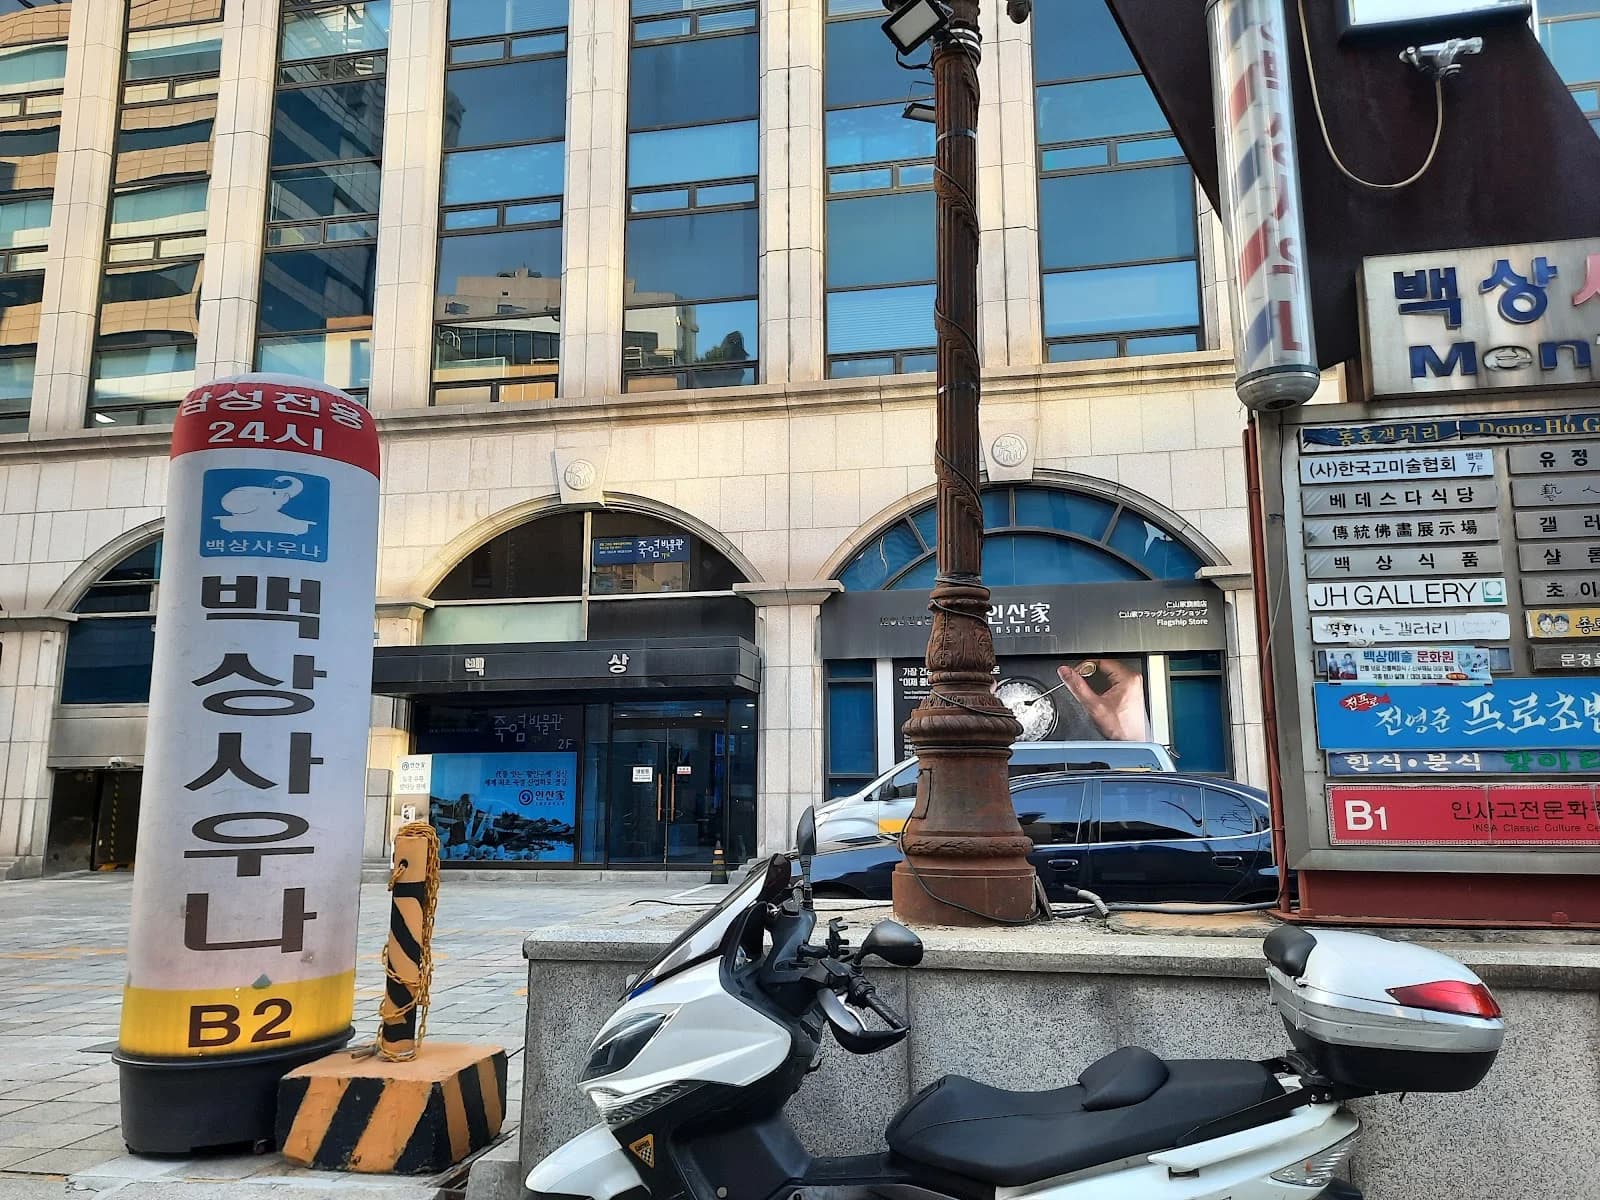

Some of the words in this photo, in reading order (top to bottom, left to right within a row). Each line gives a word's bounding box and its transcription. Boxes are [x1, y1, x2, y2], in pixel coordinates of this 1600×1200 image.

[1409, 337, 1600, 379] Men
[181, 390, 364, 430] 남성전용
[208, 421, 324, 451] 24시
[1309, 455, 1457, 478] (사)한국고미술협회
[206, 539, 321, 558] 백상사우나
[1314, 585, 1347, 606] JH
[1353, 582, 1477, 605] GALLERY
[1157, 619, 1187, 627] Flagship
[608, 654, 629, 674] 상
[1416, 650, 1454, 663] 문화원
[1375, 704, 1451, 736] 전영준
[558, 738, 574, 749] 2F
[184, 576, 327, 953] 백상사우나
[1344, 800, 1388, 831] B1
[1503, 823, 1539, 832] Classic
[187, 999, 291, 1047] B2
